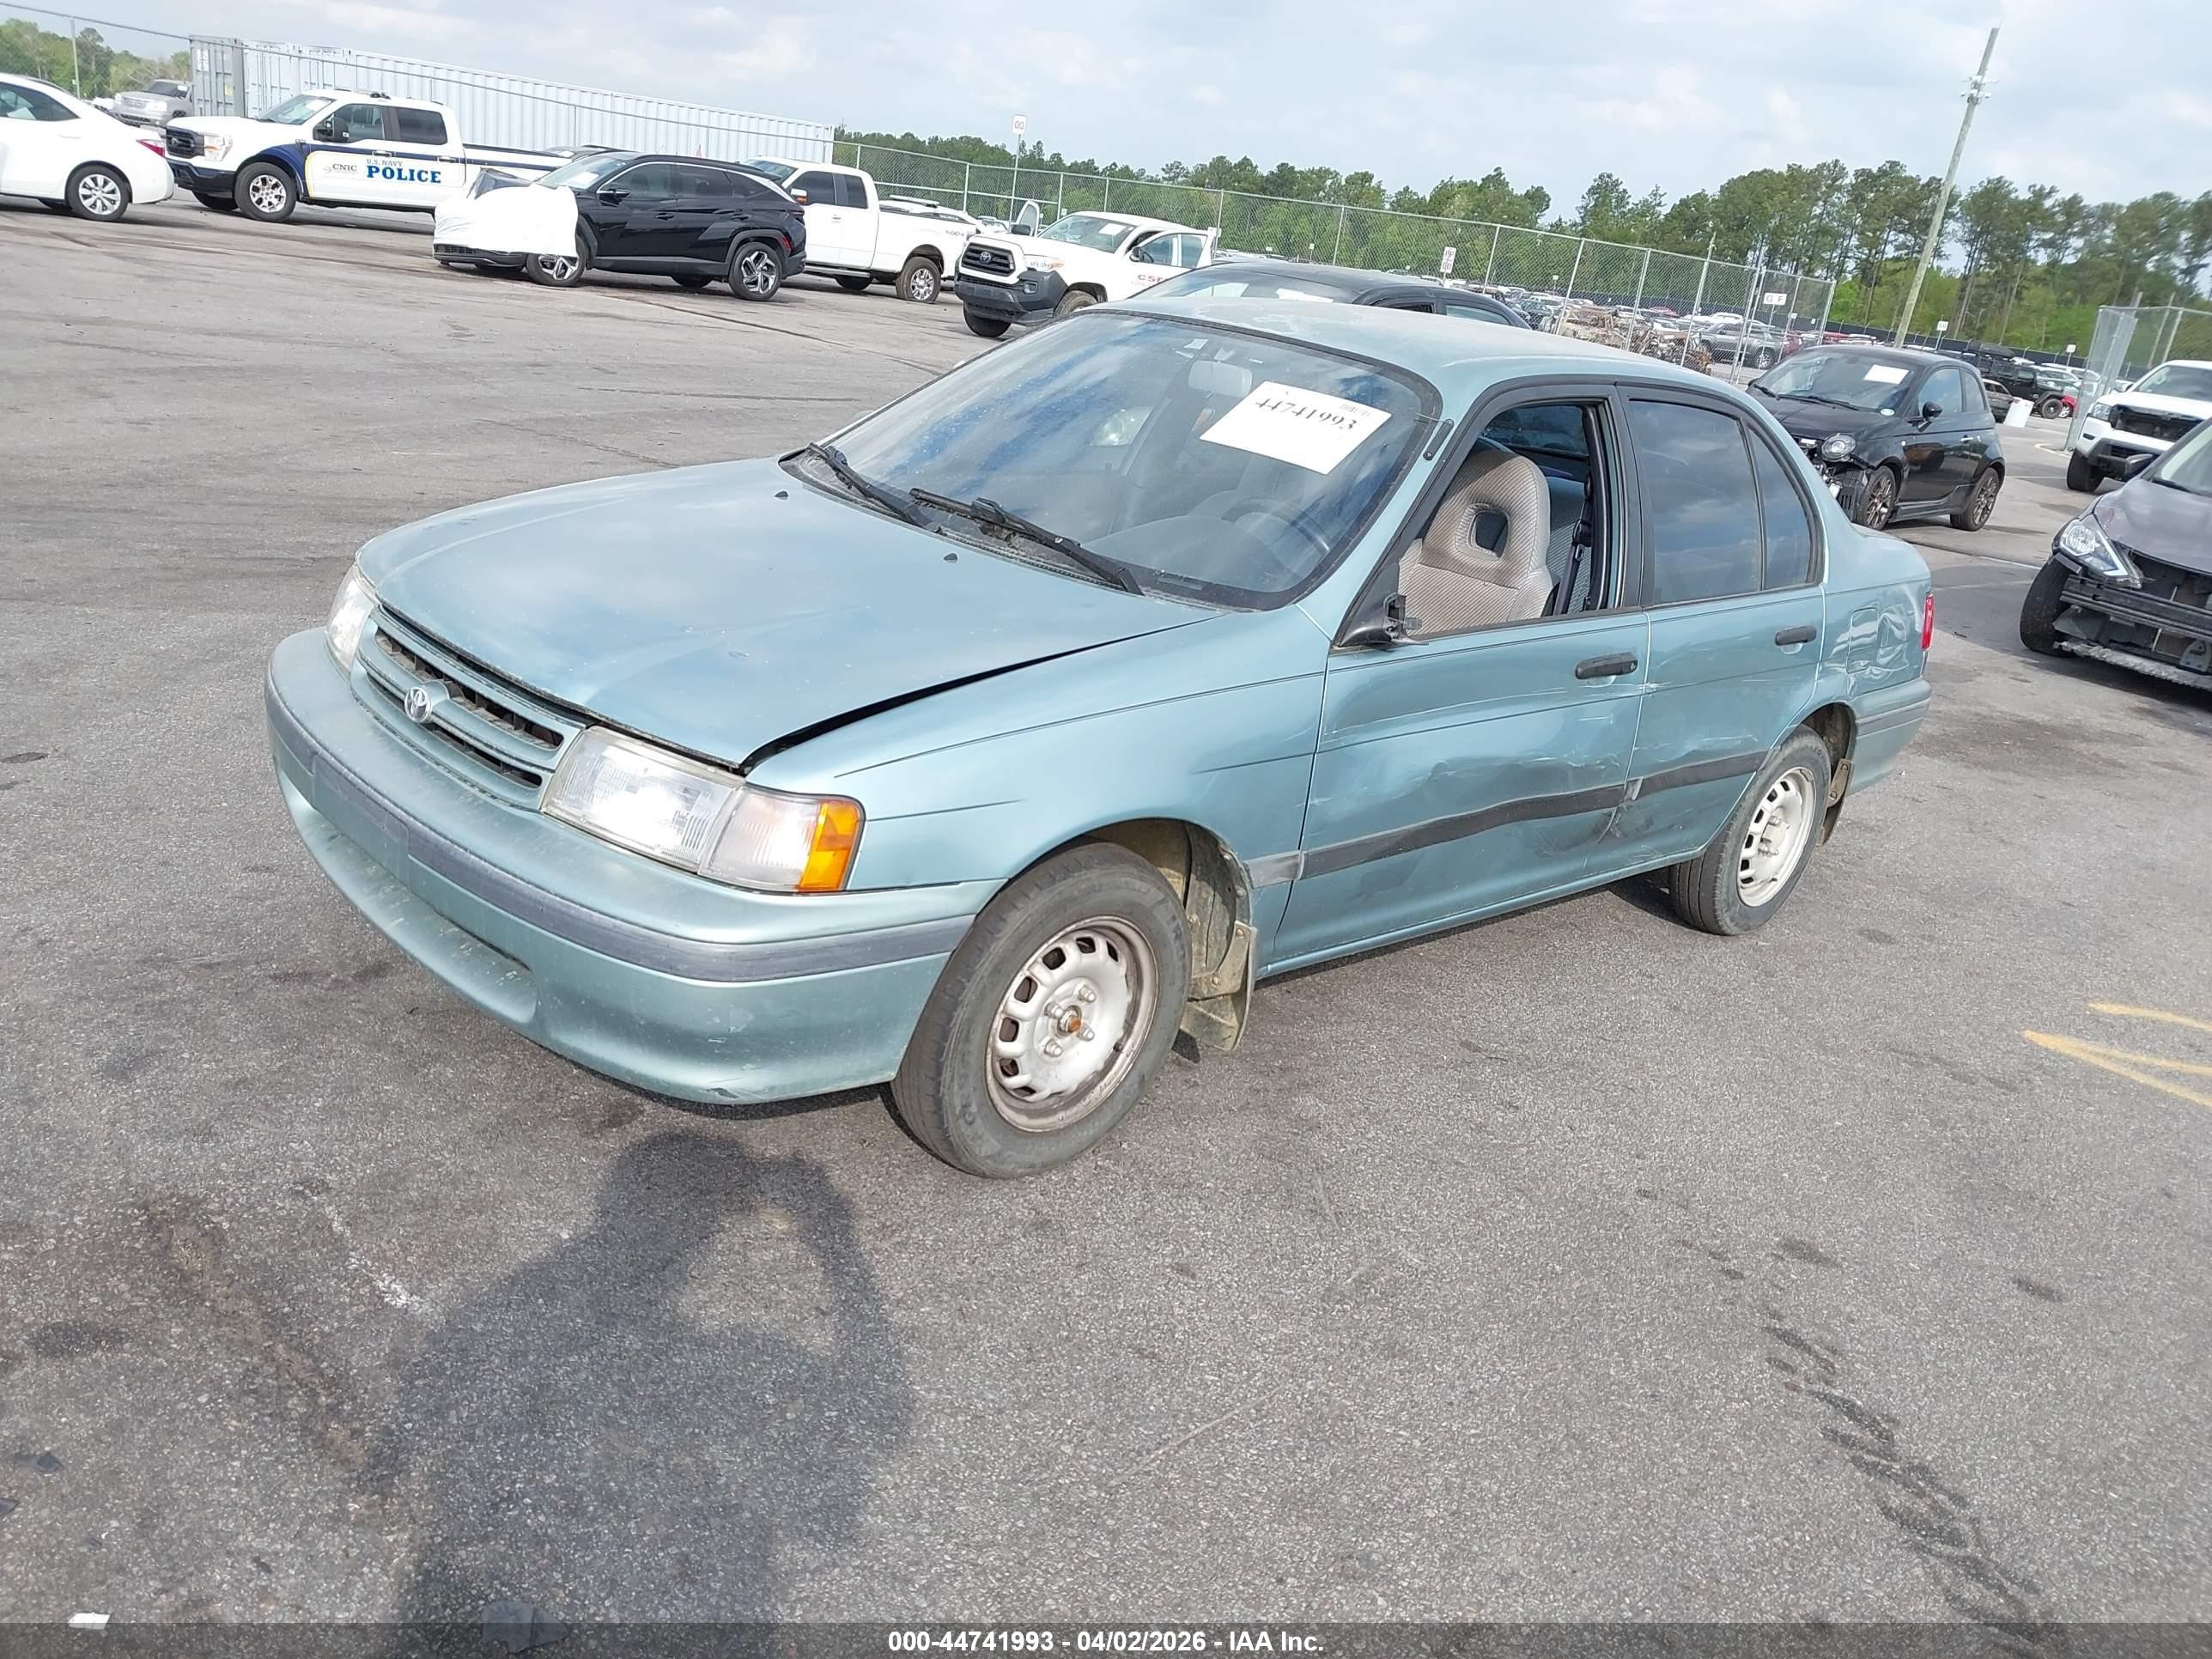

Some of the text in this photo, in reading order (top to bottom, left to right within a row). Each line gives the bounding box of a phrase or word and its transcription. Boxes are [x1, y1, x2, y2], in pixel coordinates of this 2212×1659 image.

[332, 163, 357, 172] CNIC
[366, 165, 441, 184] POLICE
[1255, 398, 1358, 430] 44741993
